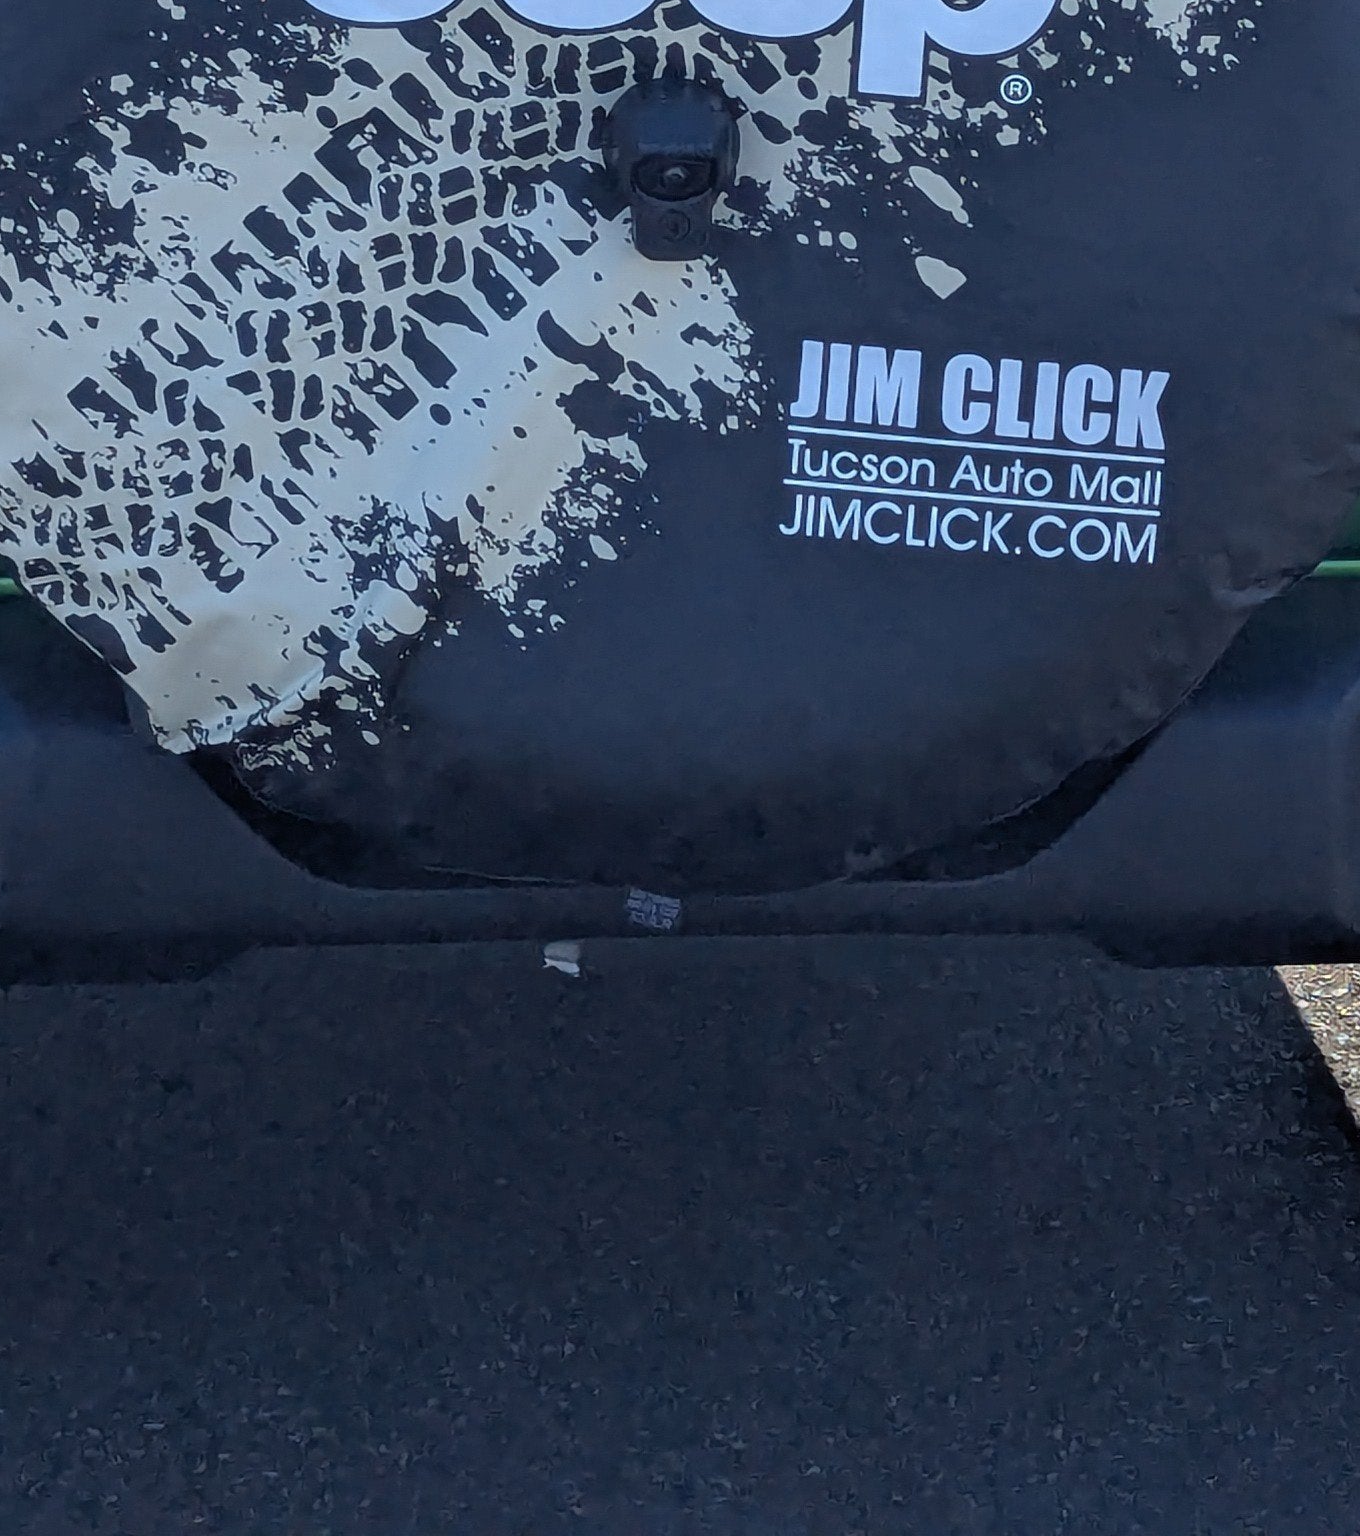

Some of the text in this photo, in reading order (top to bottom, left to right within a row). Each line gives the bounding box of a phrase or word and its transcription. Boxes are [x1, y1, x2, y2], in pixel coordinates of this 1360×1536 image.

[789, 339, 1171, 450] JIM CLICK
[787, 438, 1163, 507] Tucson Auto Mall
[778, 493, 1158, 564] JIMCLICK.COM
